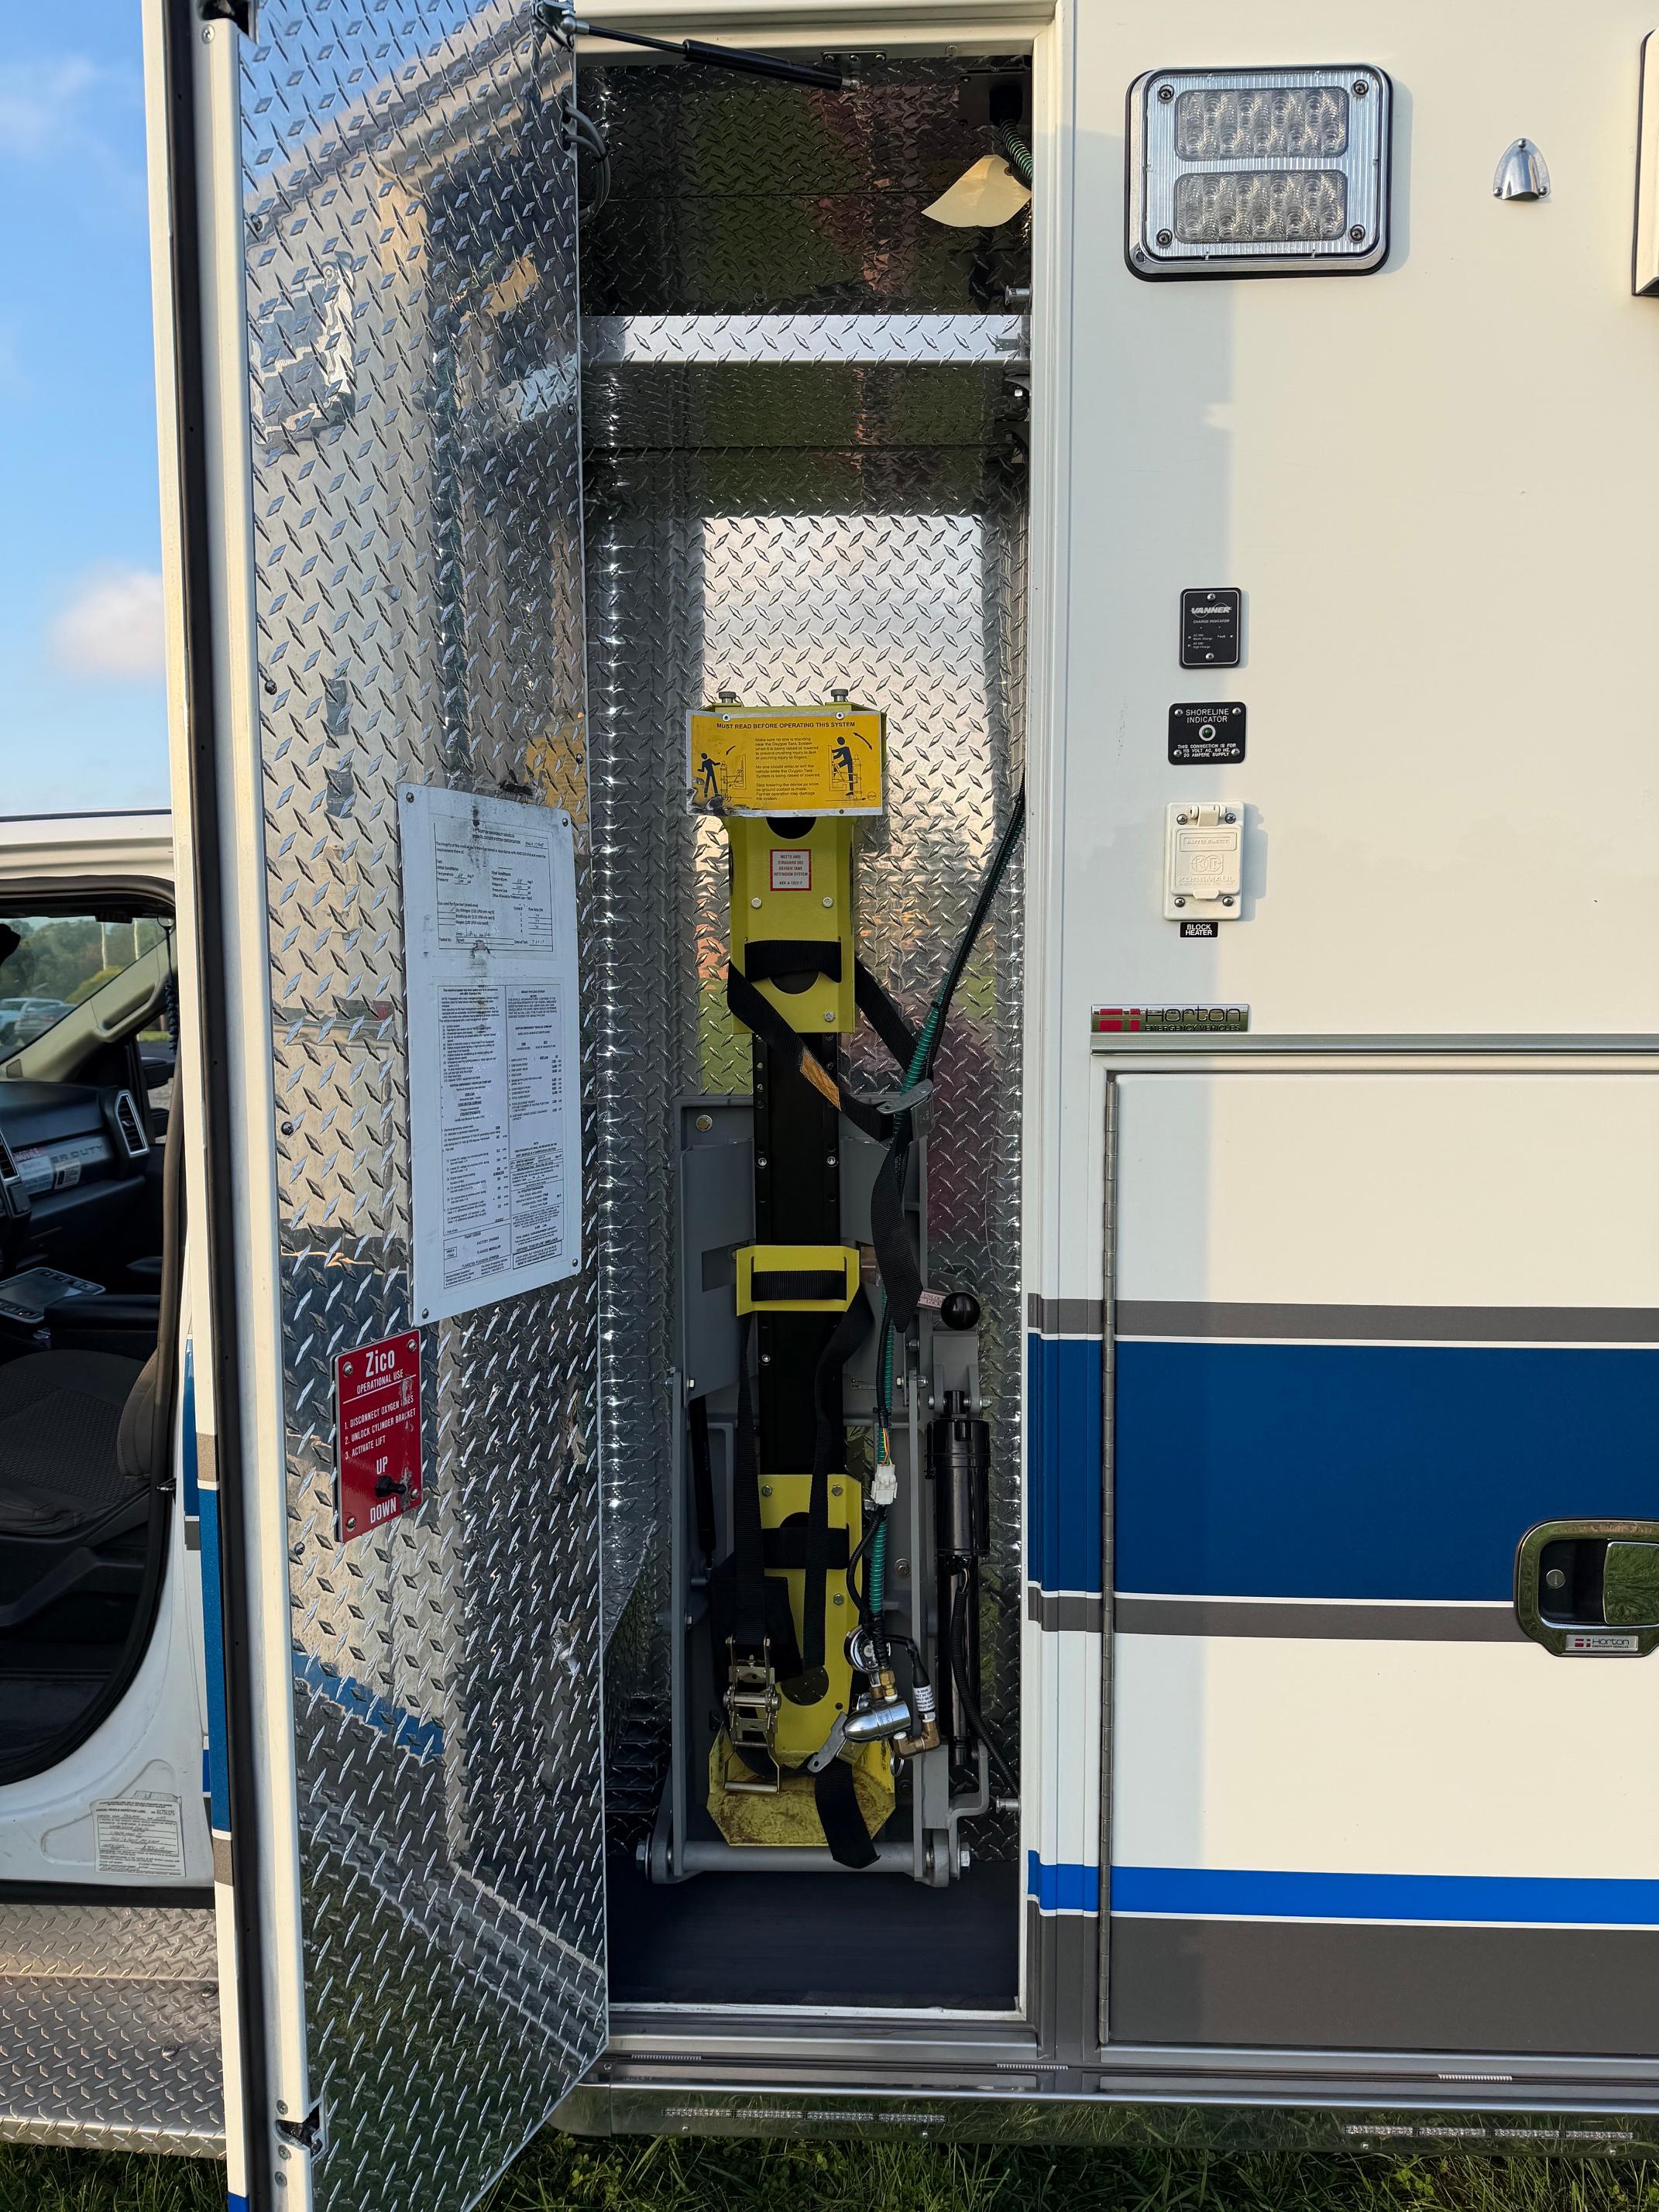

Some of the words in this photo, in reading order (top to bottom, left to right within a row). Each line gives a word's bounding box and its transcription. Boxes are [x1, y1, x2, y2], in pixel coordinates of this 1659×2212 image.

[1146, 1006, 1241, 1022] Horton
[366, 1350, 395, 1378] Zico
[357, 1376, 392, 1394] OPERATIONAL
[393, 1369, 403, 1380] USE
[345, 1436, 349, 1444] 2.
[351, 1427, 370, 1442] UNLOCK
[372, 1418, 394, 1434] CYLINDER
[395, 1408, 416, 1424] BRACKET
[350, 1409, 380, 1427] DISCONNECT
[381, 1402, 399, 1415] OXYGEN
[345, 1451, 349, 1460] 3.
[352, 1441, 374, 1457] ACTIVATE
[376, 1435, 386, 1447] LIFT
[376, 1456, 388, 1475] UP
[370, 1497, 397, 1523] DOWN
